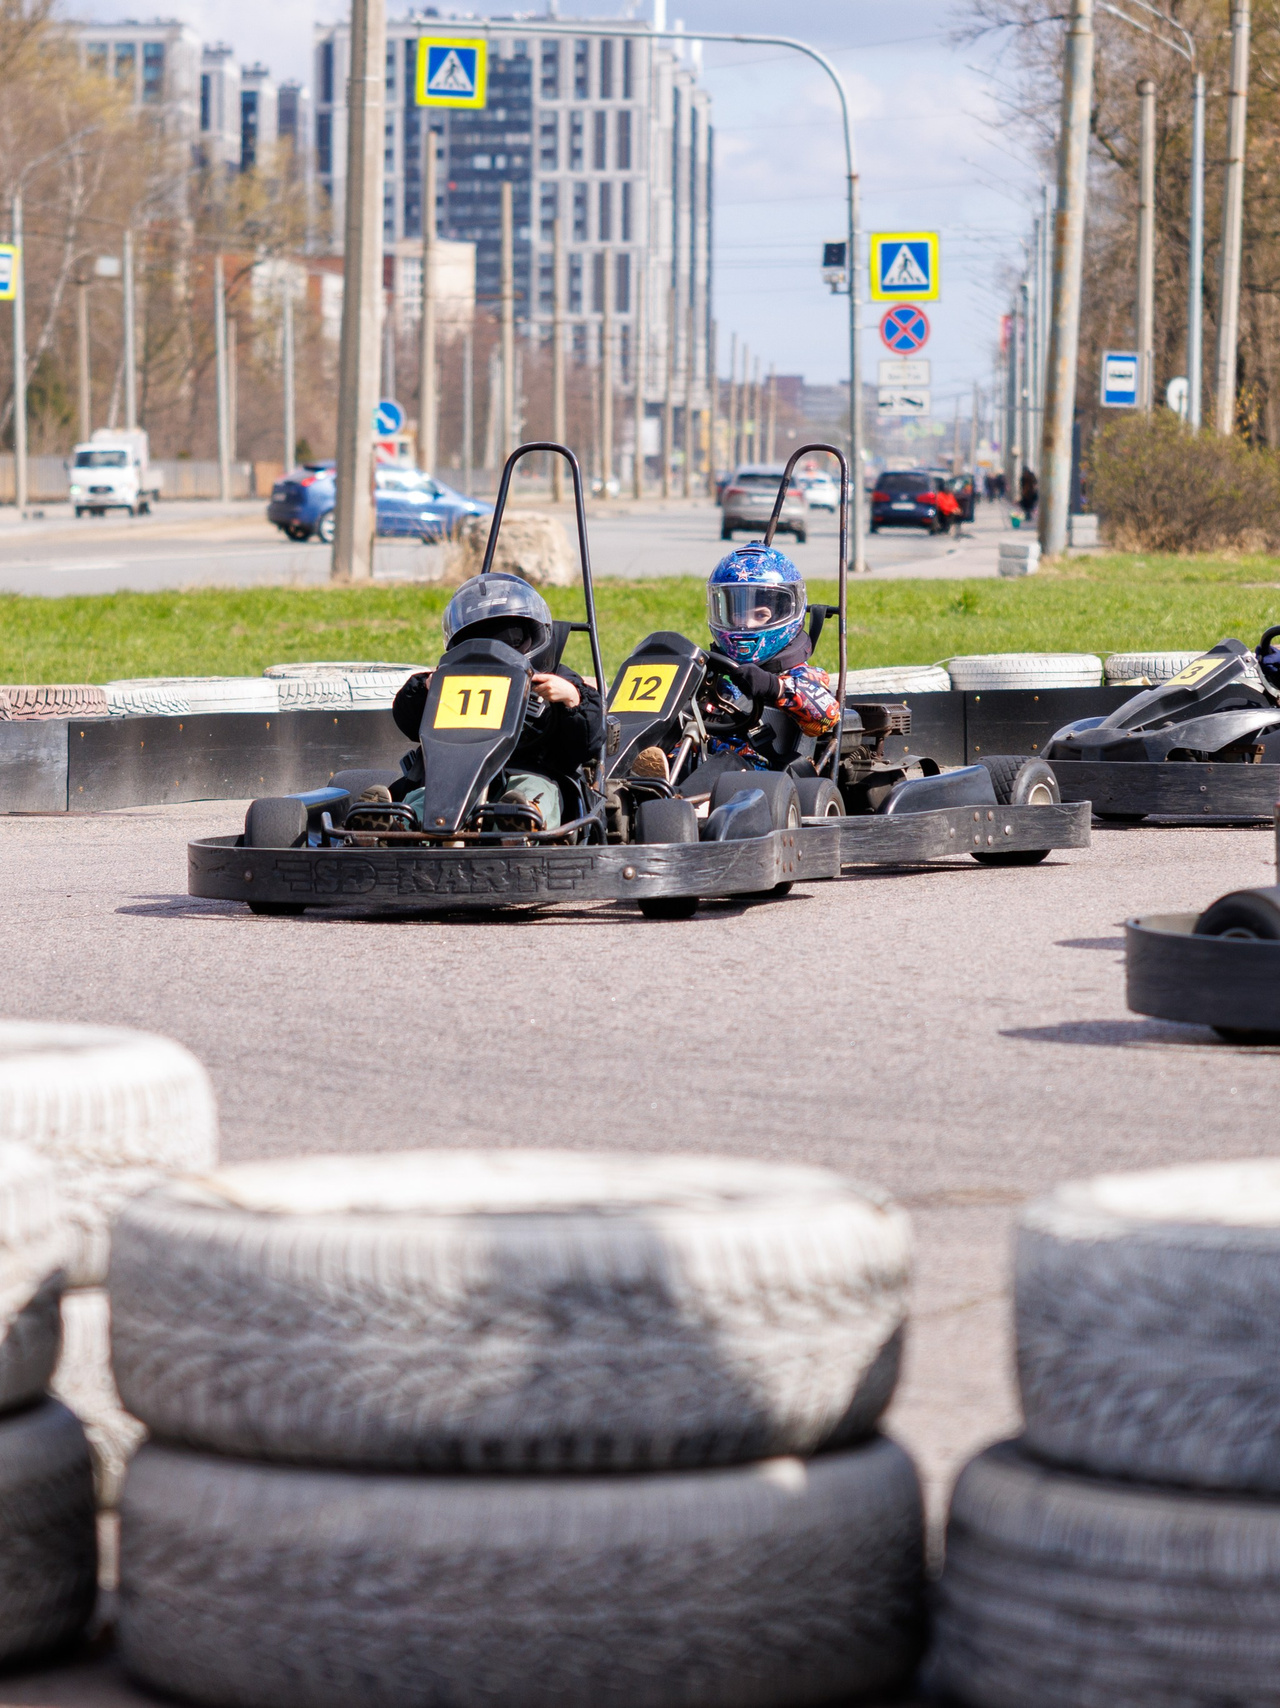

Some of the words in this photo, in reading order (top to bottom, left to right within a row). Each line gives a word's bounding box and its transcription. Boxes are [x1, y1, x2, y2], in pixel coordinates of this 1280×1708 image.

[1180, 665, 1204, 680] 3
[628, 675, 663, 701] 12
[457, 689, 492, 716] 11
